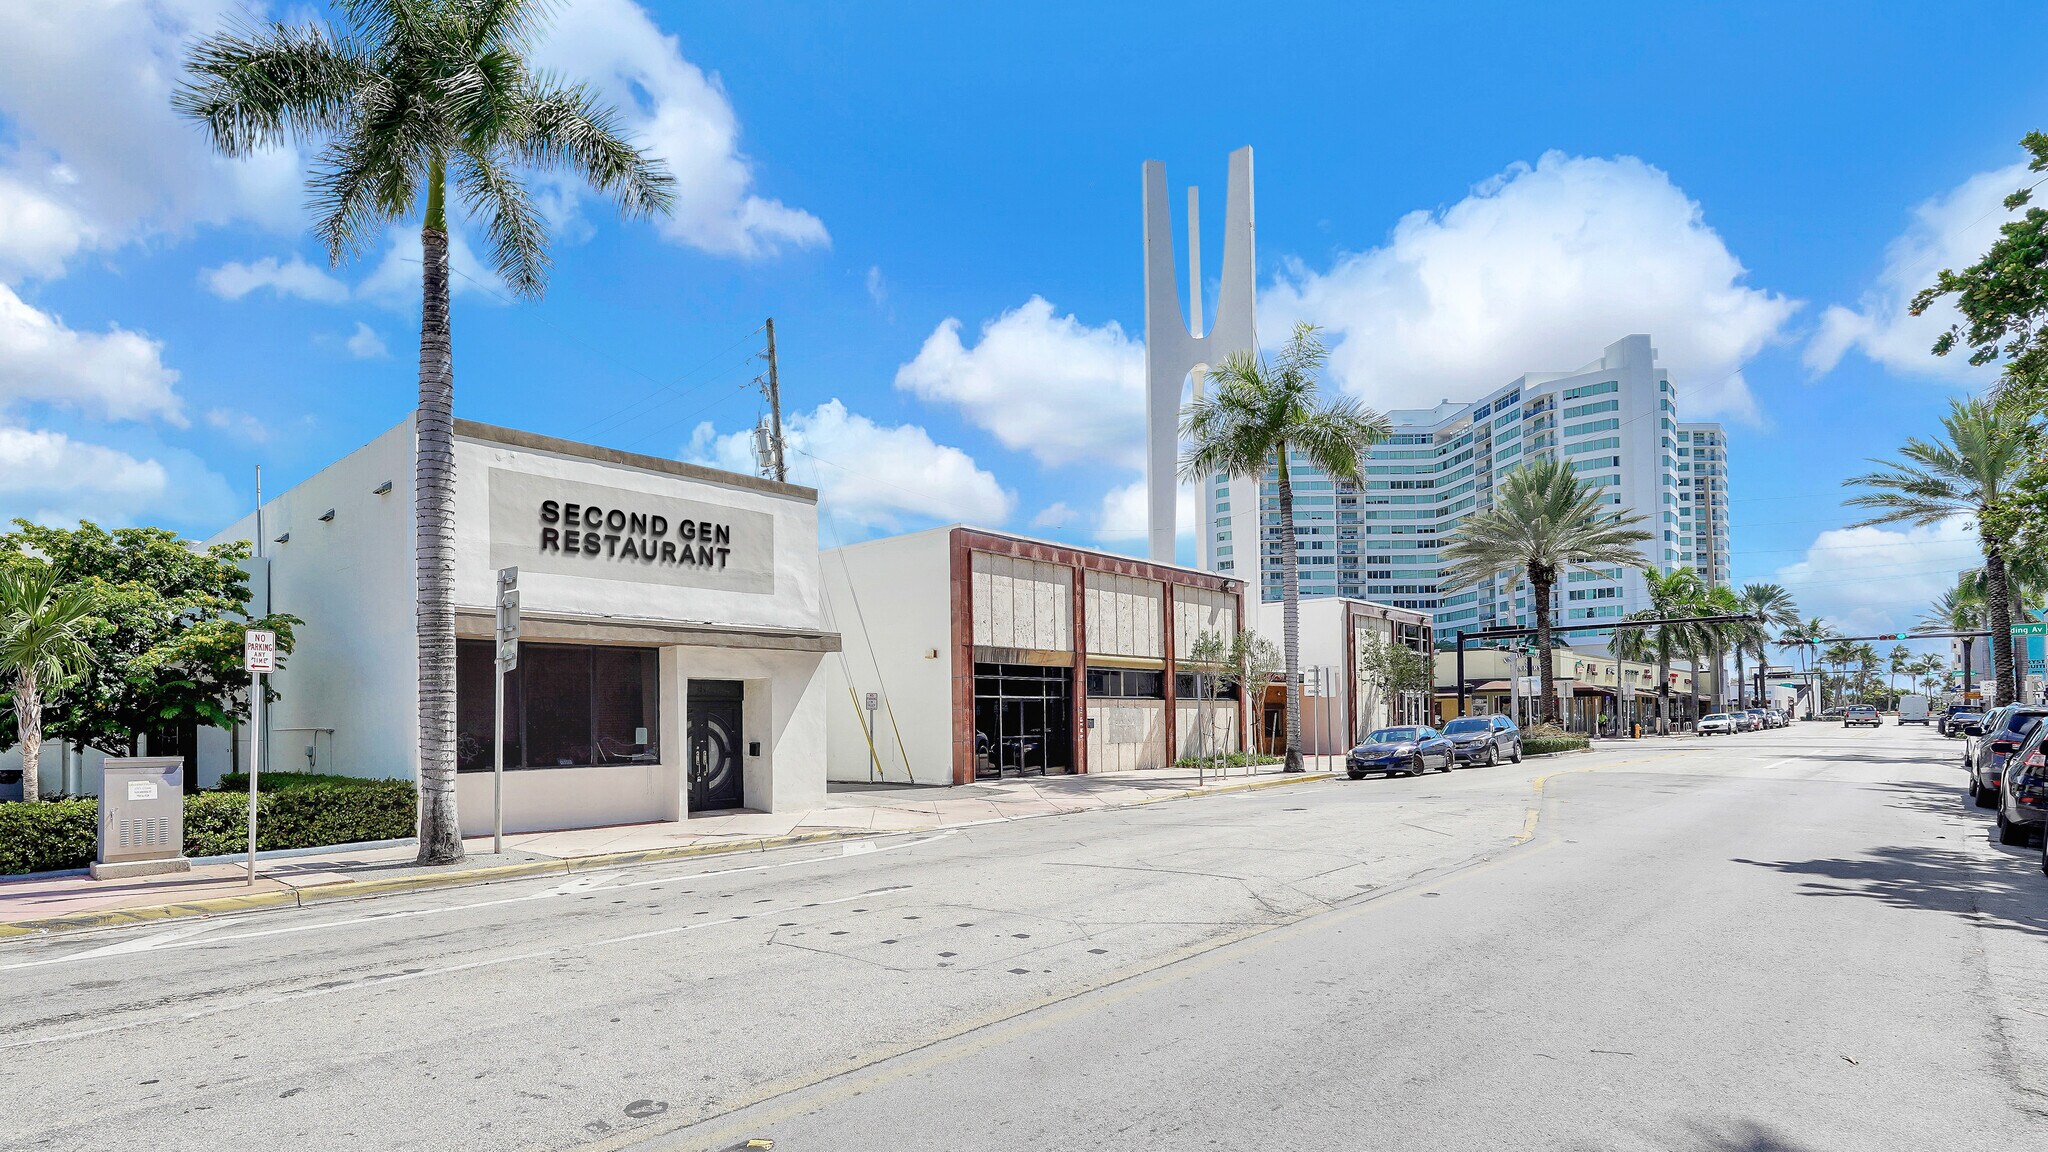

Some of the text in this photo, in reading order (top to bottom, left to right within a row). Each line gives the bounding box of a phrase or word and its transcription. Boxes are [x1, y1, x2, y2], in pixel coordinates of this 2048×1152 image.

[541, 500, 730, 544] SECOND GEN
[541, 527, 731, 567] RESTAURANT
[248, 643, 272, 652] PARKING
[255, 634, 265, 642] NO
